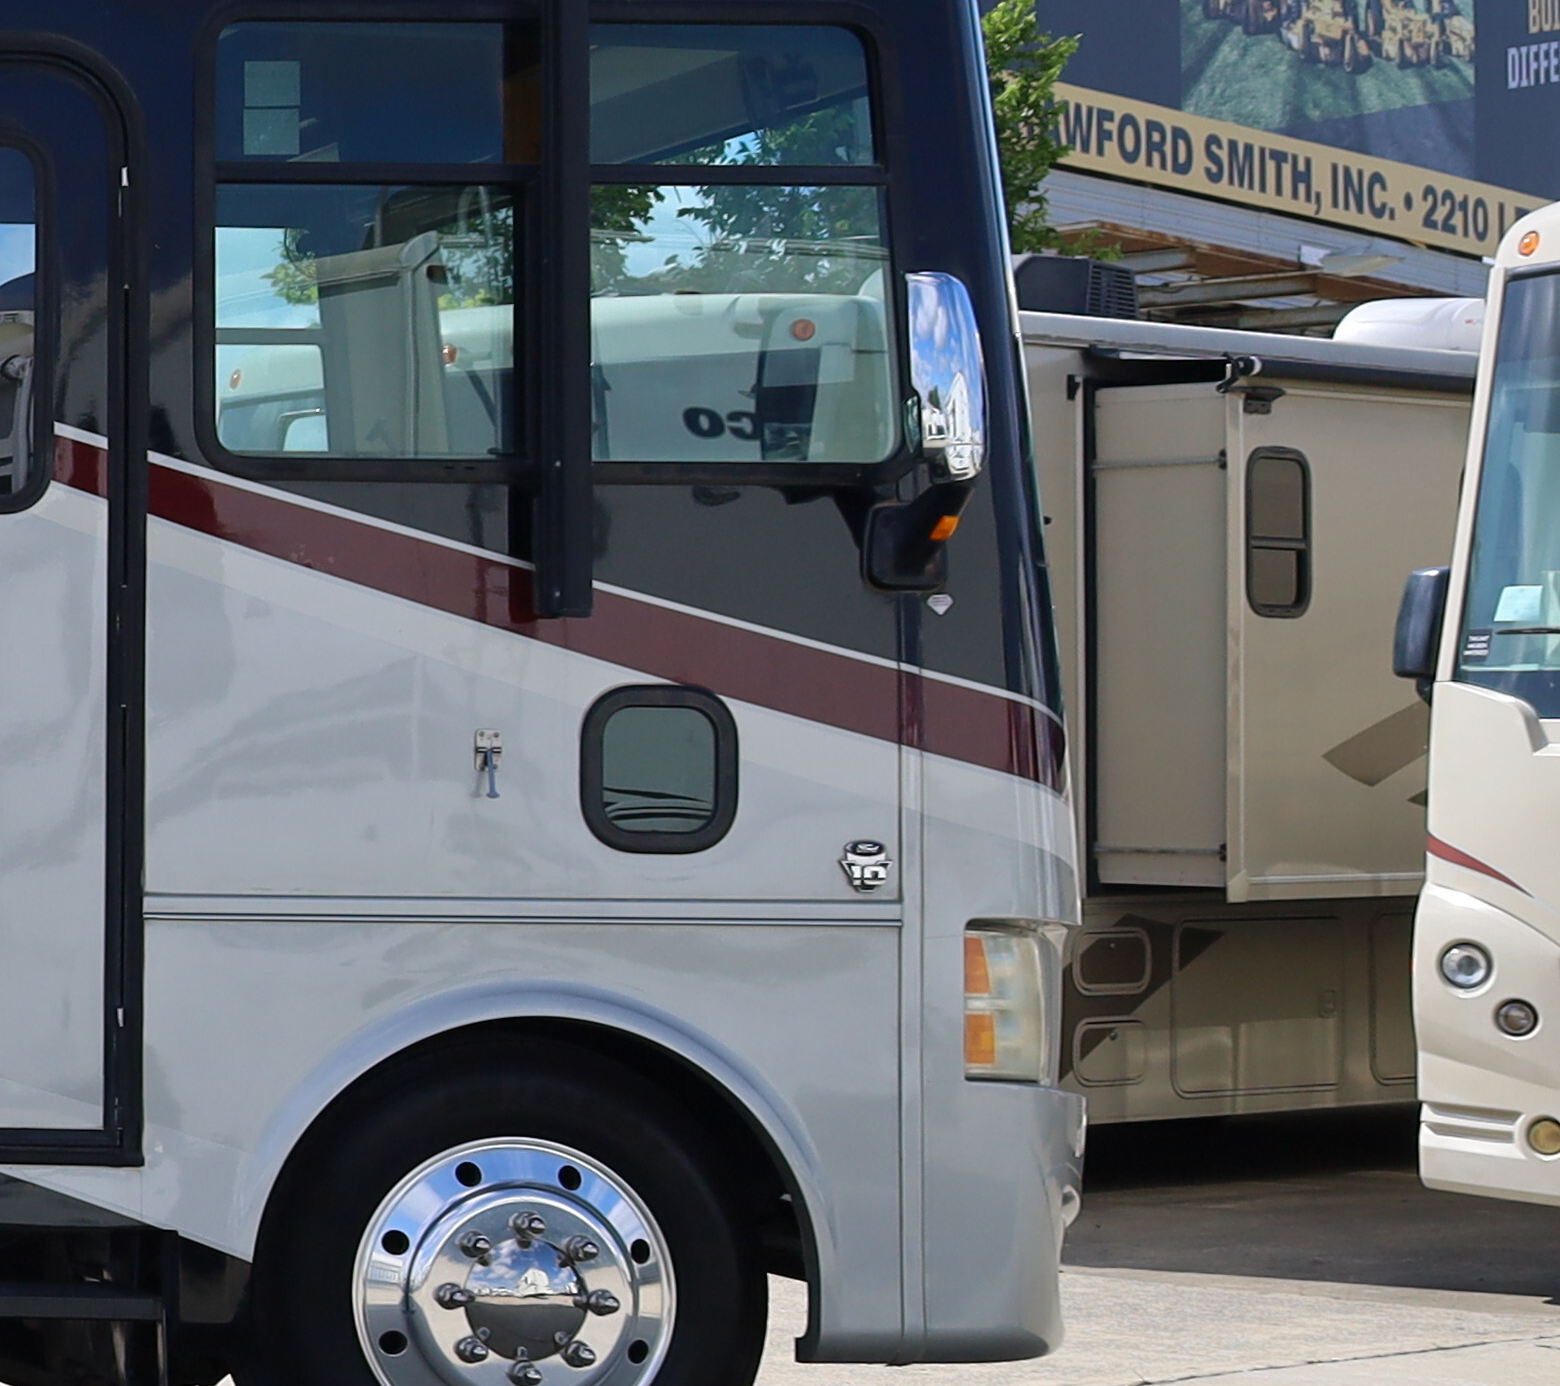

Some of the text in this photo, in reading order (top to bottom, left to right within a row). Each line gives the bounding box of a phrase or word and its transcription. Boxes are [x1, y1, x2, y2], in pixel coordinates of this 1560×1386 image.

[1204, 133, 1322, 216] SMITH,
[1331, 162, 1396, 221] INC.
[1422, 184, 1489, 242] 2210
